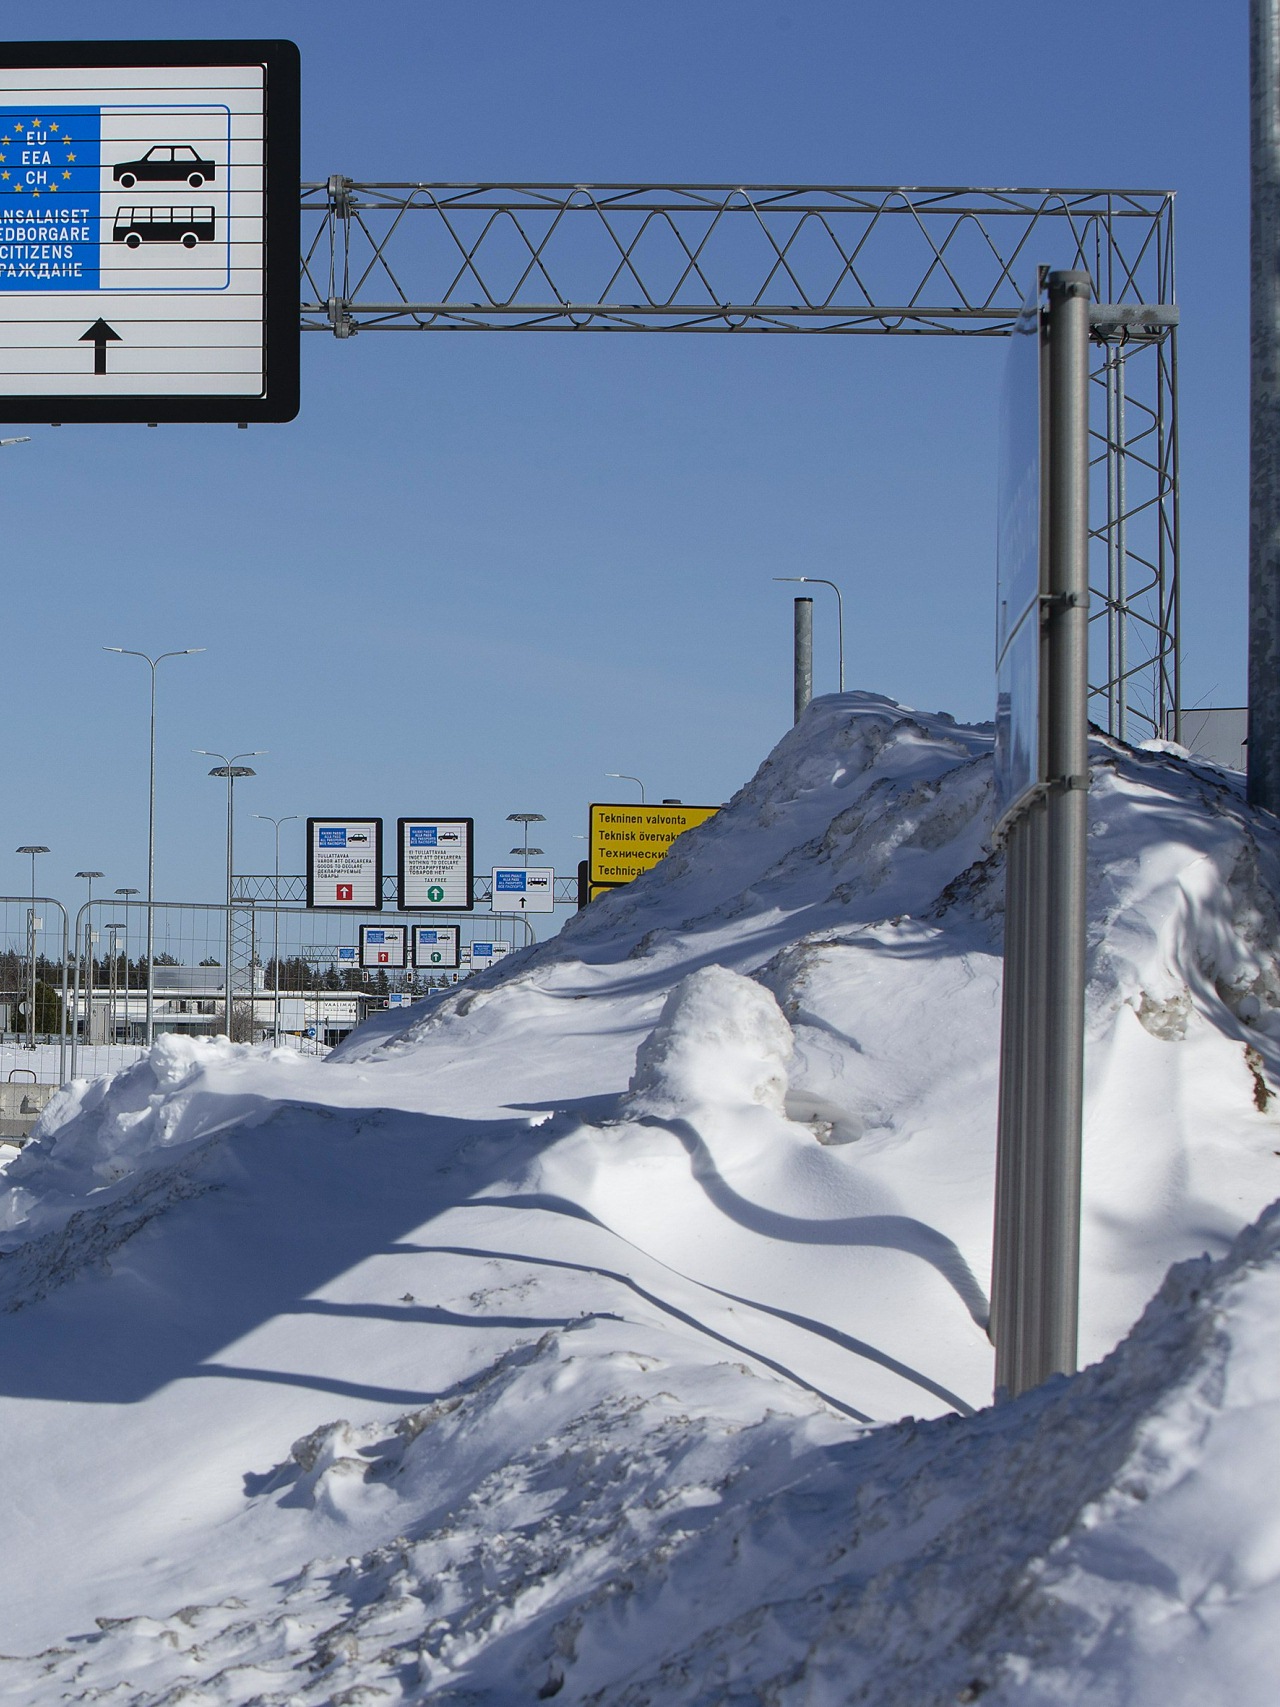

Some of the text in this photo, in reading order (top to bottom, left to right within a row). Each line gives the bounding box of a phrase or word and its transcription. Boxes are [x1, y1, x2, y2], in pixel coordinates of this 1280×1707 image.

[26, 131, 47, 146] EU
[22, 150, 51, 165] EEA
[25, 170, 47, 185] CH
[0, 245, 73, 260] CITIZENS
[598, 812, 687, 825] Tekninen valvonta
[598, 830, 636, 841] Teknisk
